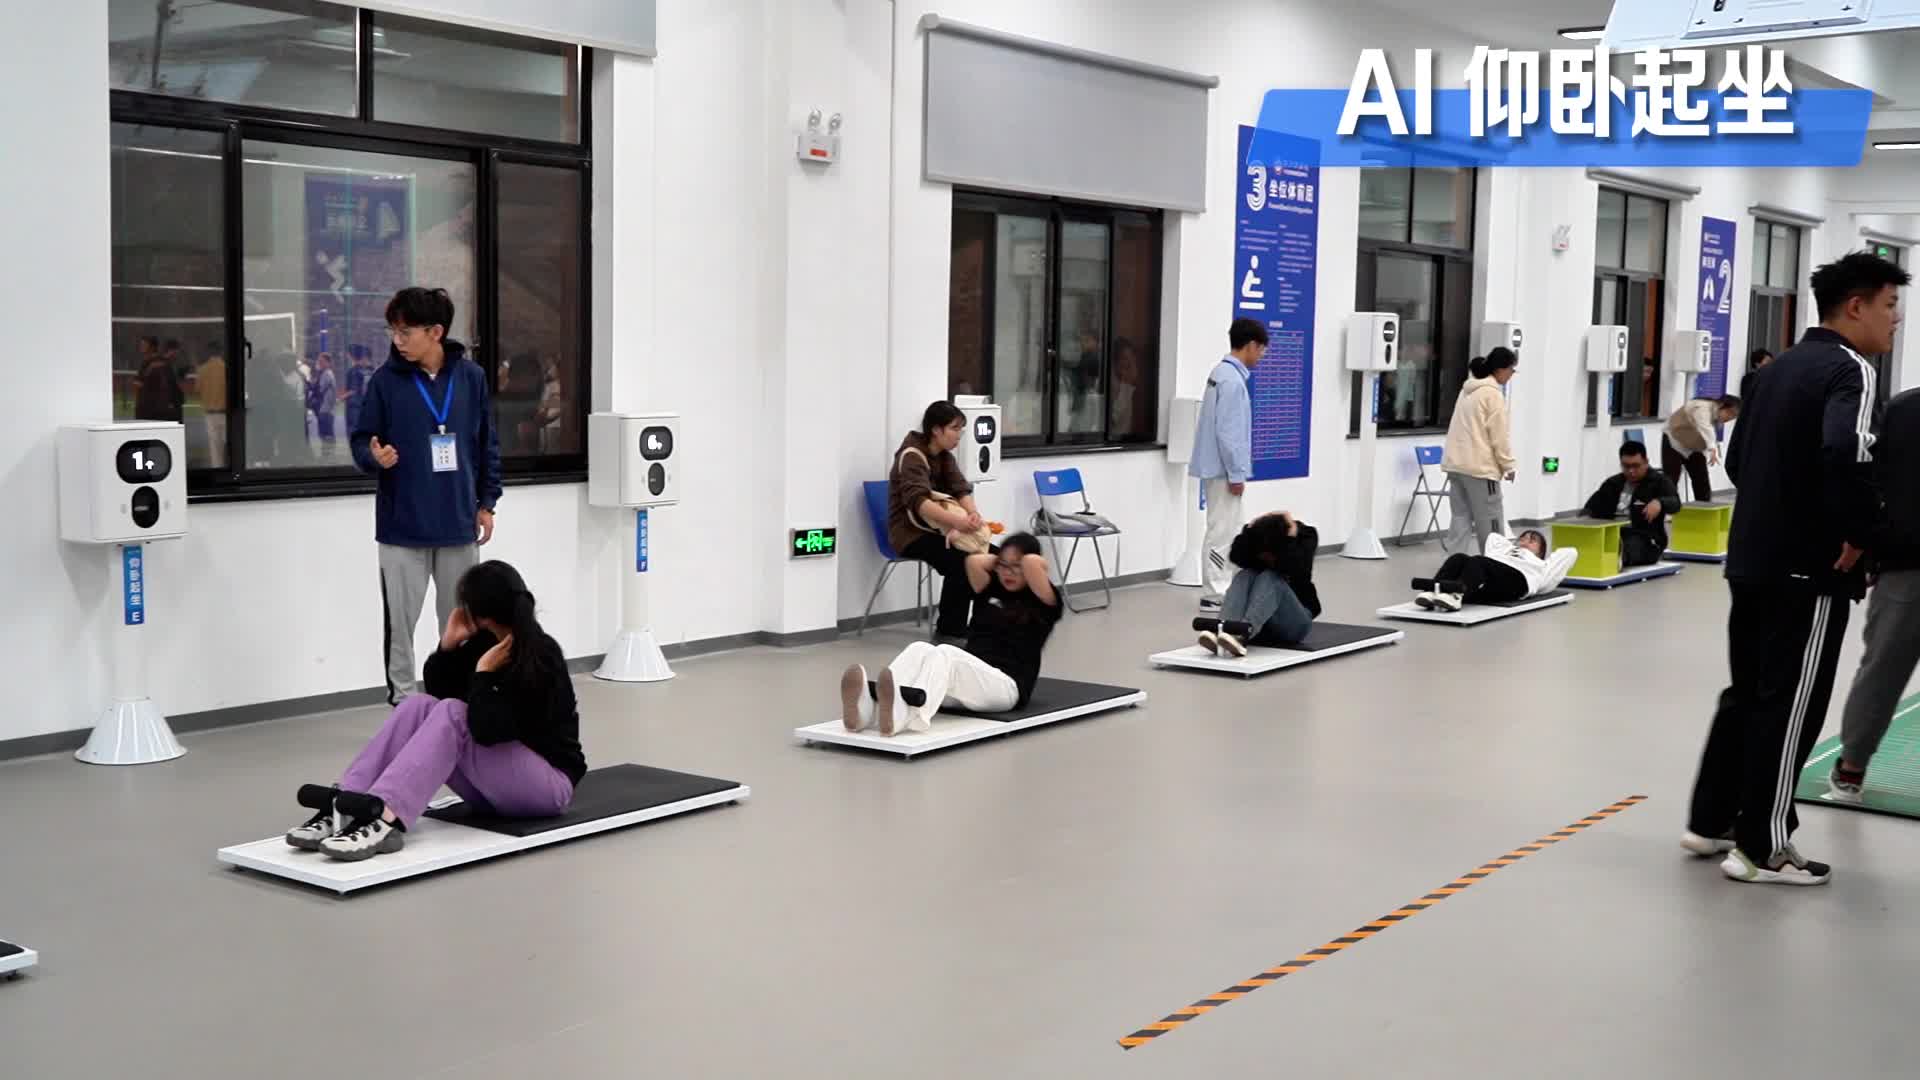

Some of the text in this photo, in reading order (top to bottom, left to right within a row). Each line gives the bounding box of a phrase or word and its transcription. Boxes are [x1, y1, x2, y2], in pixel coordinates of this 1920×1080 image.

[1246, 159, 1267, 211] 3
[1717, 258, 1731, 314] 2
[131, 610, 141, 622] E
